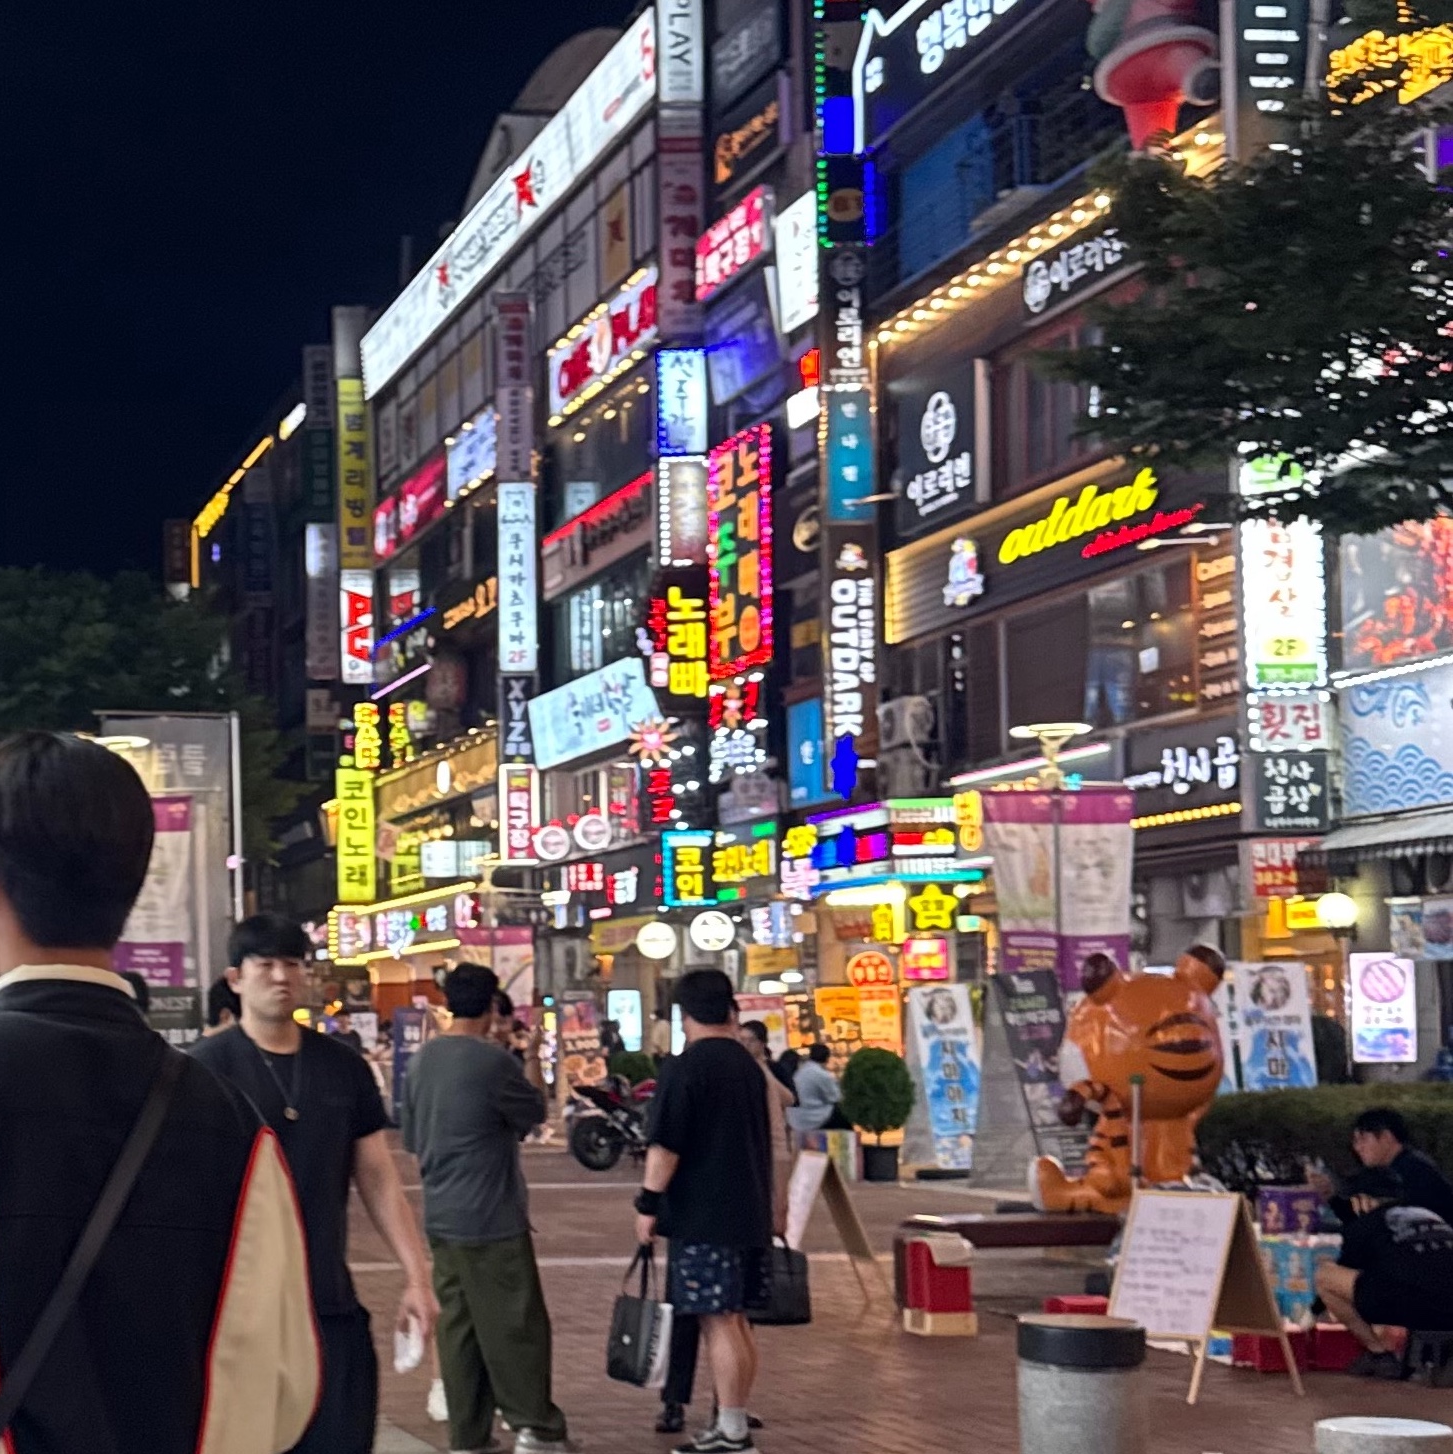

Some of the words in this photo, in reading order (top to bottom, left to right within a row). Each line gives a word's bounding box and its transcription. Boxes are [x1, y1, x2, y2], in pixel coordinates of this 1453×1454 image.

[998, 466, 1159, 565] outdark
[830, 578, 864, 738] OUTDARK
[507, 678, 528, 742] XYZ
[1259, 701, 1323, 742] 횟집
